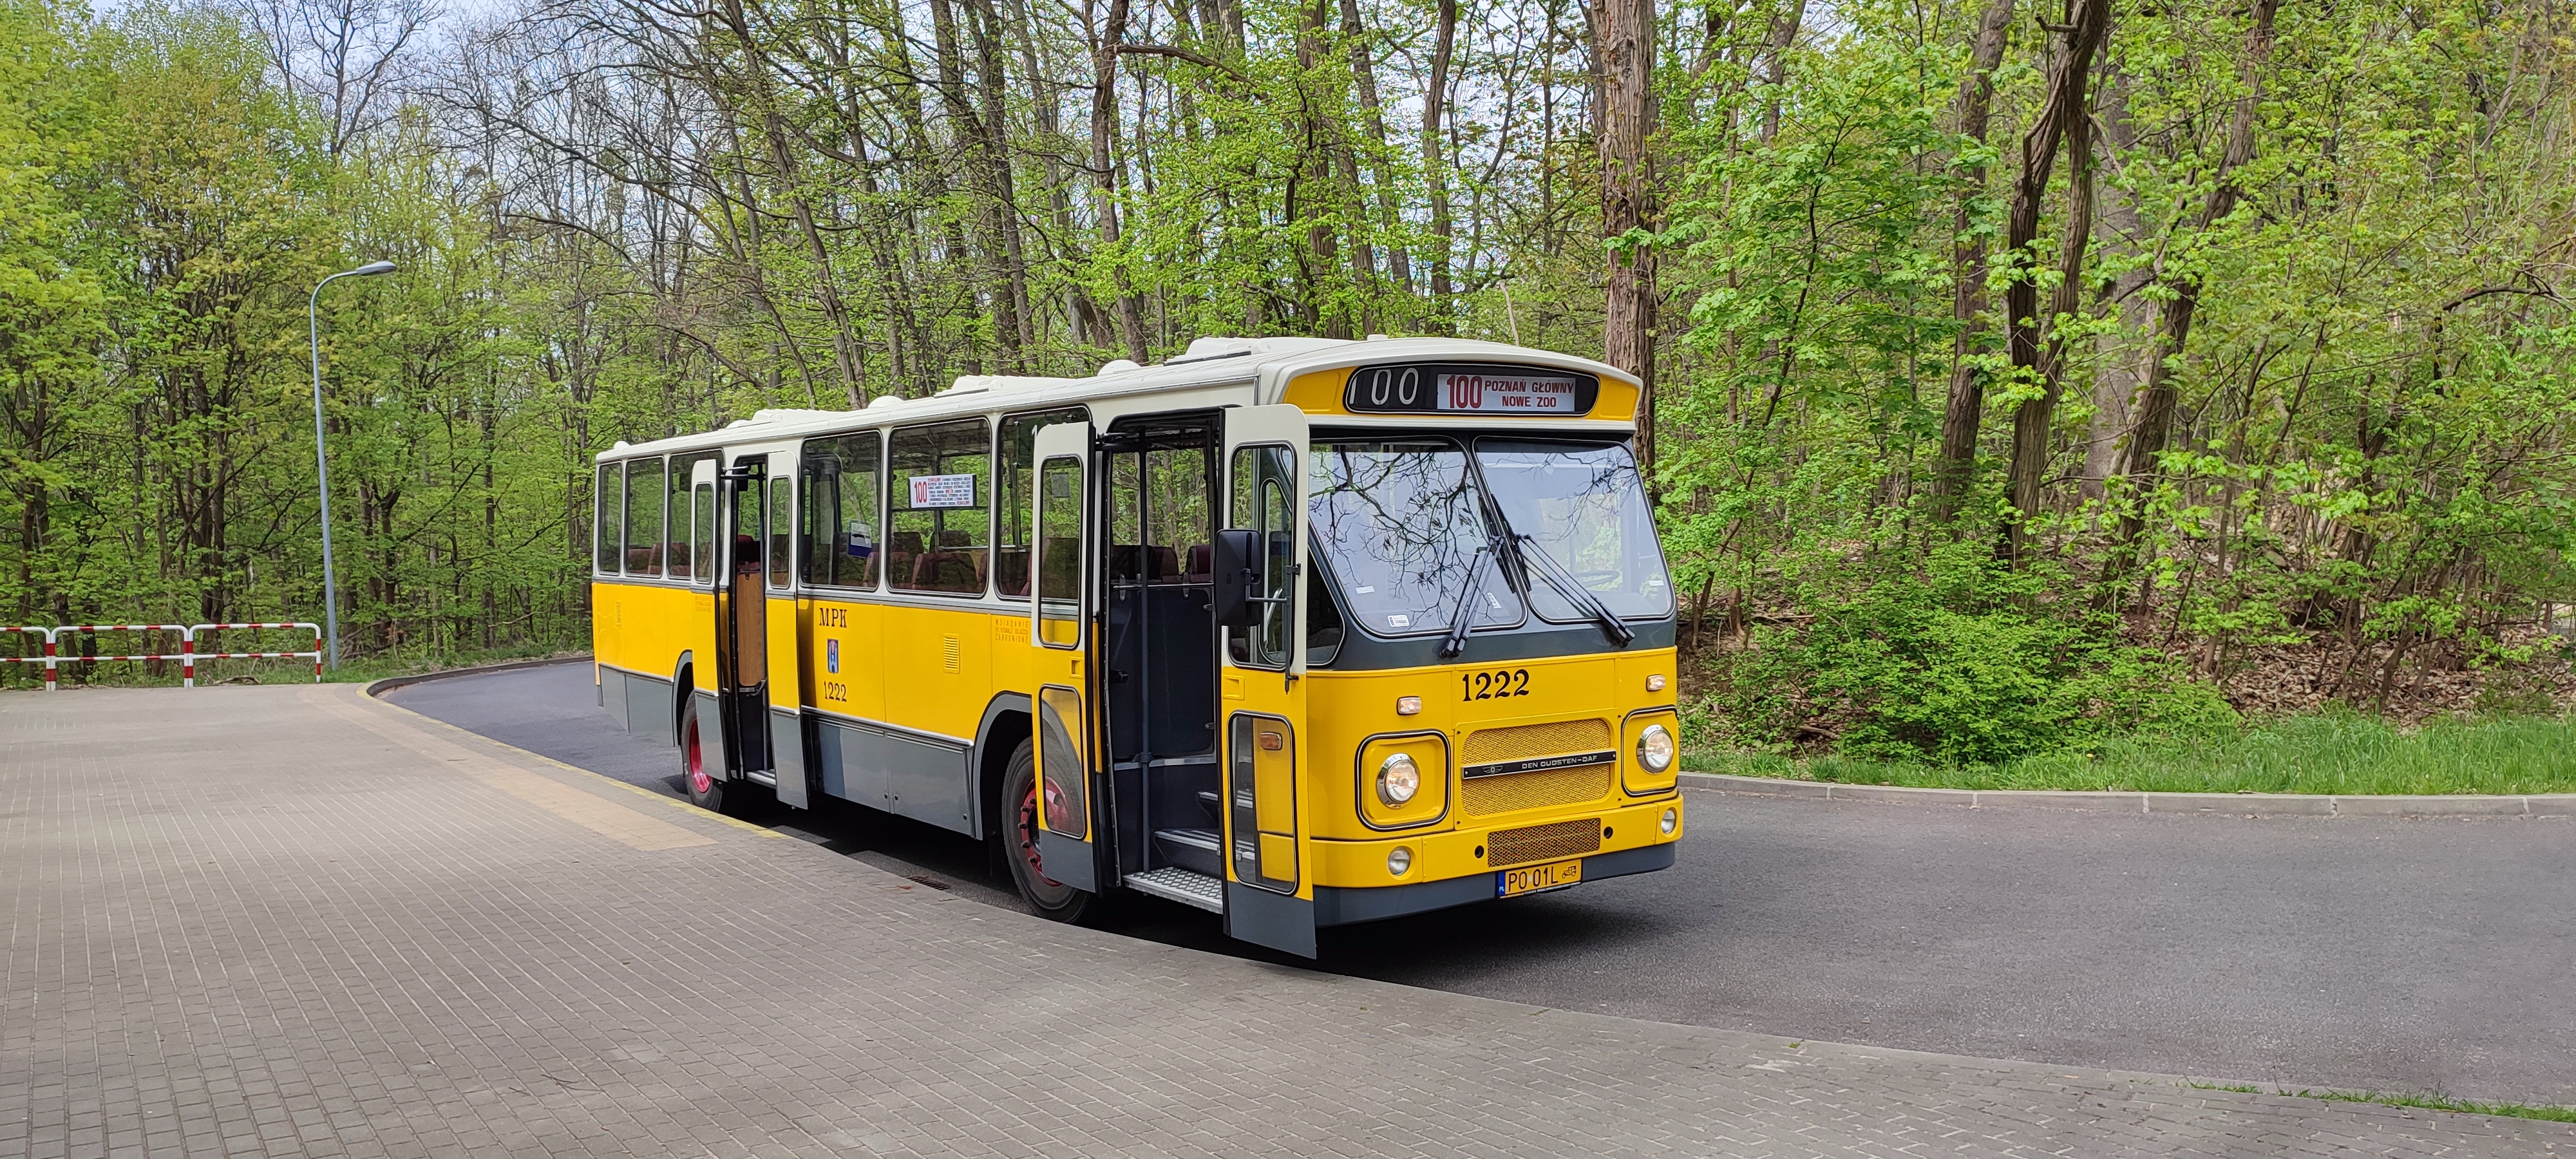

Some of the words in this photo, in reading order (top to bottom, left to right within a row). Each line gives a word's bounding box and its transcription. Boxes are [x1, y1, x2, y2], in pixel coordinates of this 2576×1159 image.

[1446, 375, 1482, 408] 100
[1484, 379, 1526, 392] POZNAŃ
[1531, 380, 1574, 393] GŁÓWNY
[1502, 395, 1531, 407] NOWE
[1537, 397, 1557, 408] ZOO
[914, 481, 927, 504] 100
[819, 607, 848, 628] MPK
[995, 619, 1028, 628] WSIADANIE
[995, 633, 1028, 643] ZABRONIONE
[824, 681, 847, 702] 1222
[1463, 669, 1530, 702] 1222
[1540, 755, 1598, 768] OUDSTEN-DAF
[1508, 871, 1527, 892] PO
[1533, 865, 1558, 887] 01L
